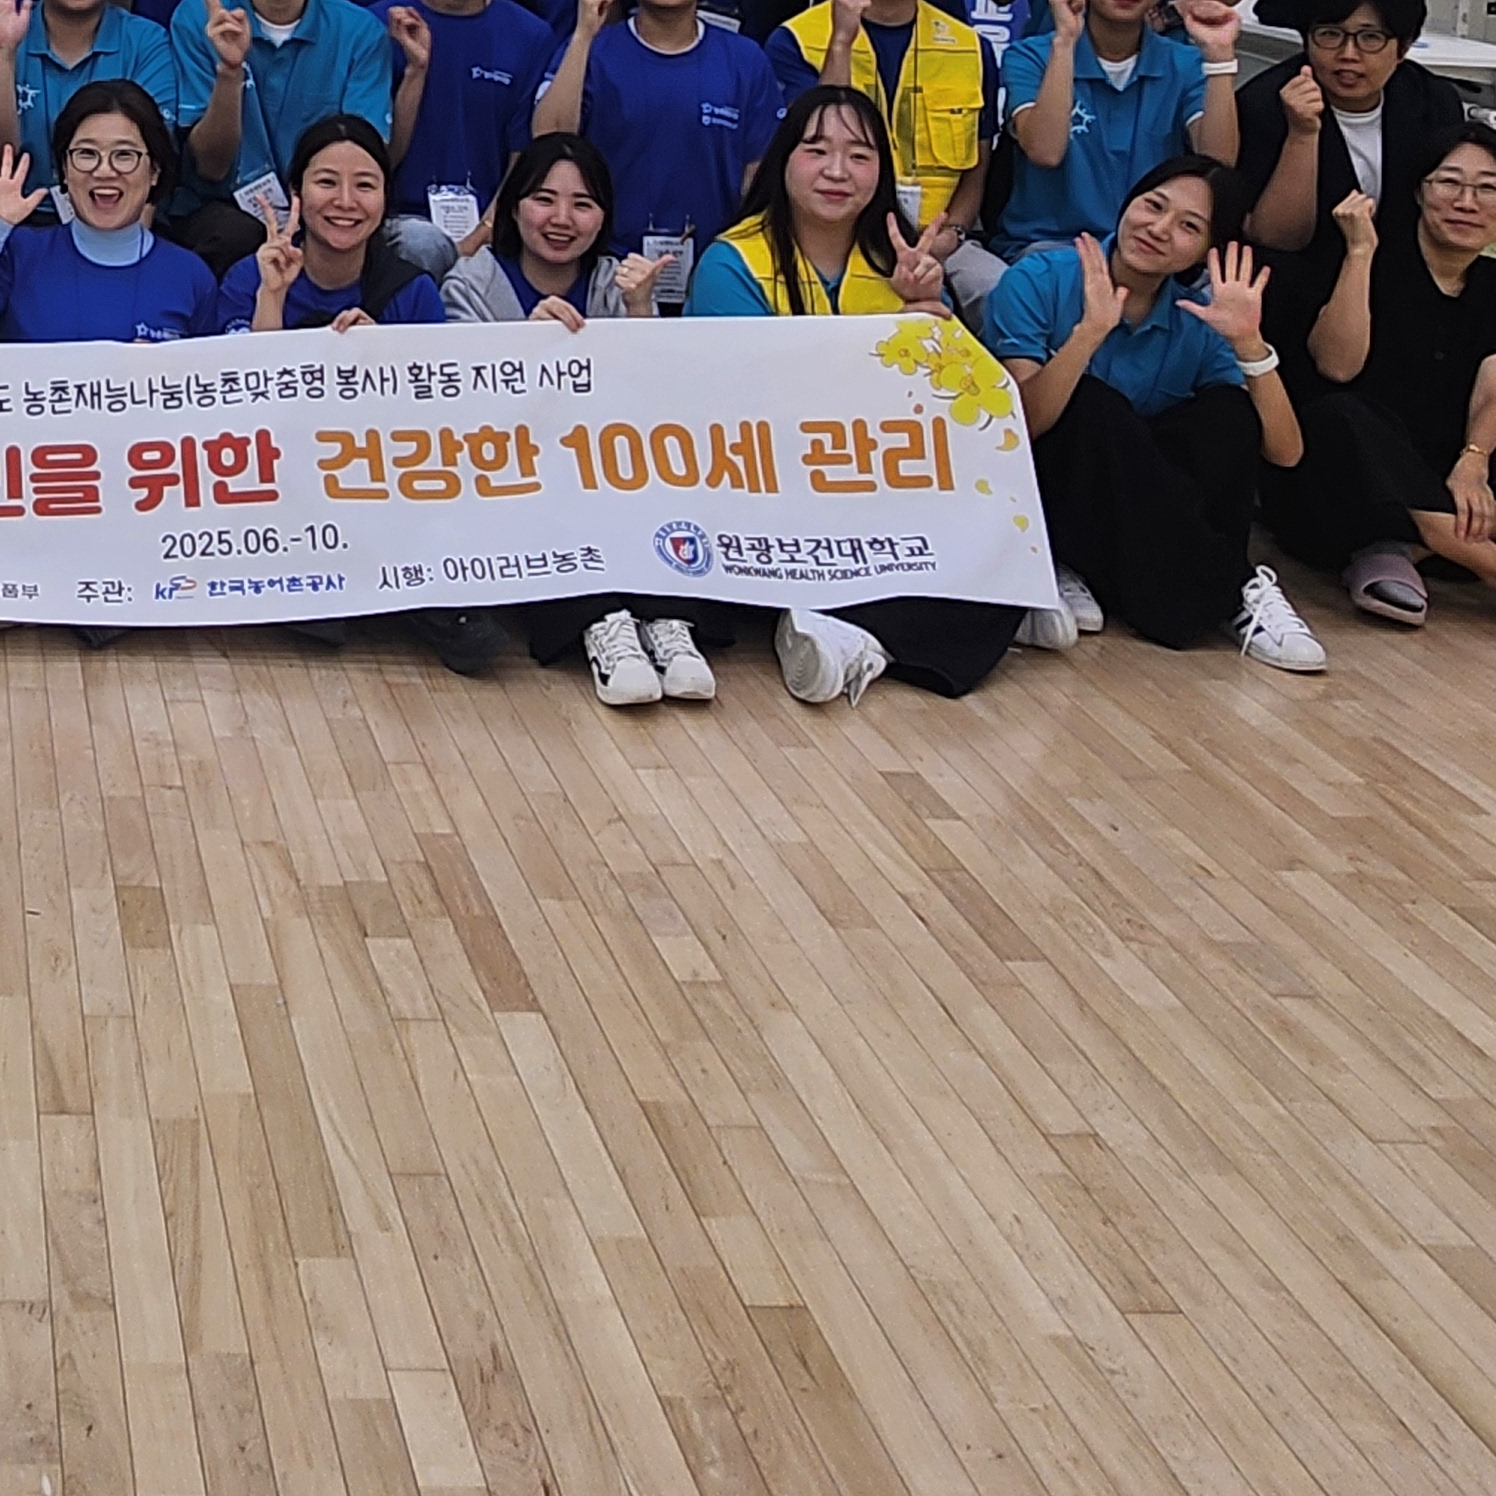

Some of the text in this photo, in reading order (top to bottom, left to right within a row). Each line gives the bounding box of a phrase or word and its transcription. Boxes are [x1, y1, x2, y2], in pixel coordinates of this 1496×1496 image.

[22, 364, 325, 416] 농촌재능나눔(농촌맞춤형
[407, 360, 462, 398] 활동
[472, 358, 526, 395] 지원
[538, 357, 593, 393] 사업
[127, 428, 281, 513] 위한
[316, 426, 540, 502] 건강한
[560, 419, 779, 495] 100세
[801, 415, 956, 492] 관리
[442, 544, 606, 585] 아이러브농촌
[716, 533, 936, 568] 원광보건대학교
[207, 573, 346, 598] 한국농어촌공사
[378, 562, 435, 591] 시행:
[722, 560, 938, 583] WONKWANG HEALTH SCIENCE UNIVERSITY
[76, 579, 133, 606] 주관:
